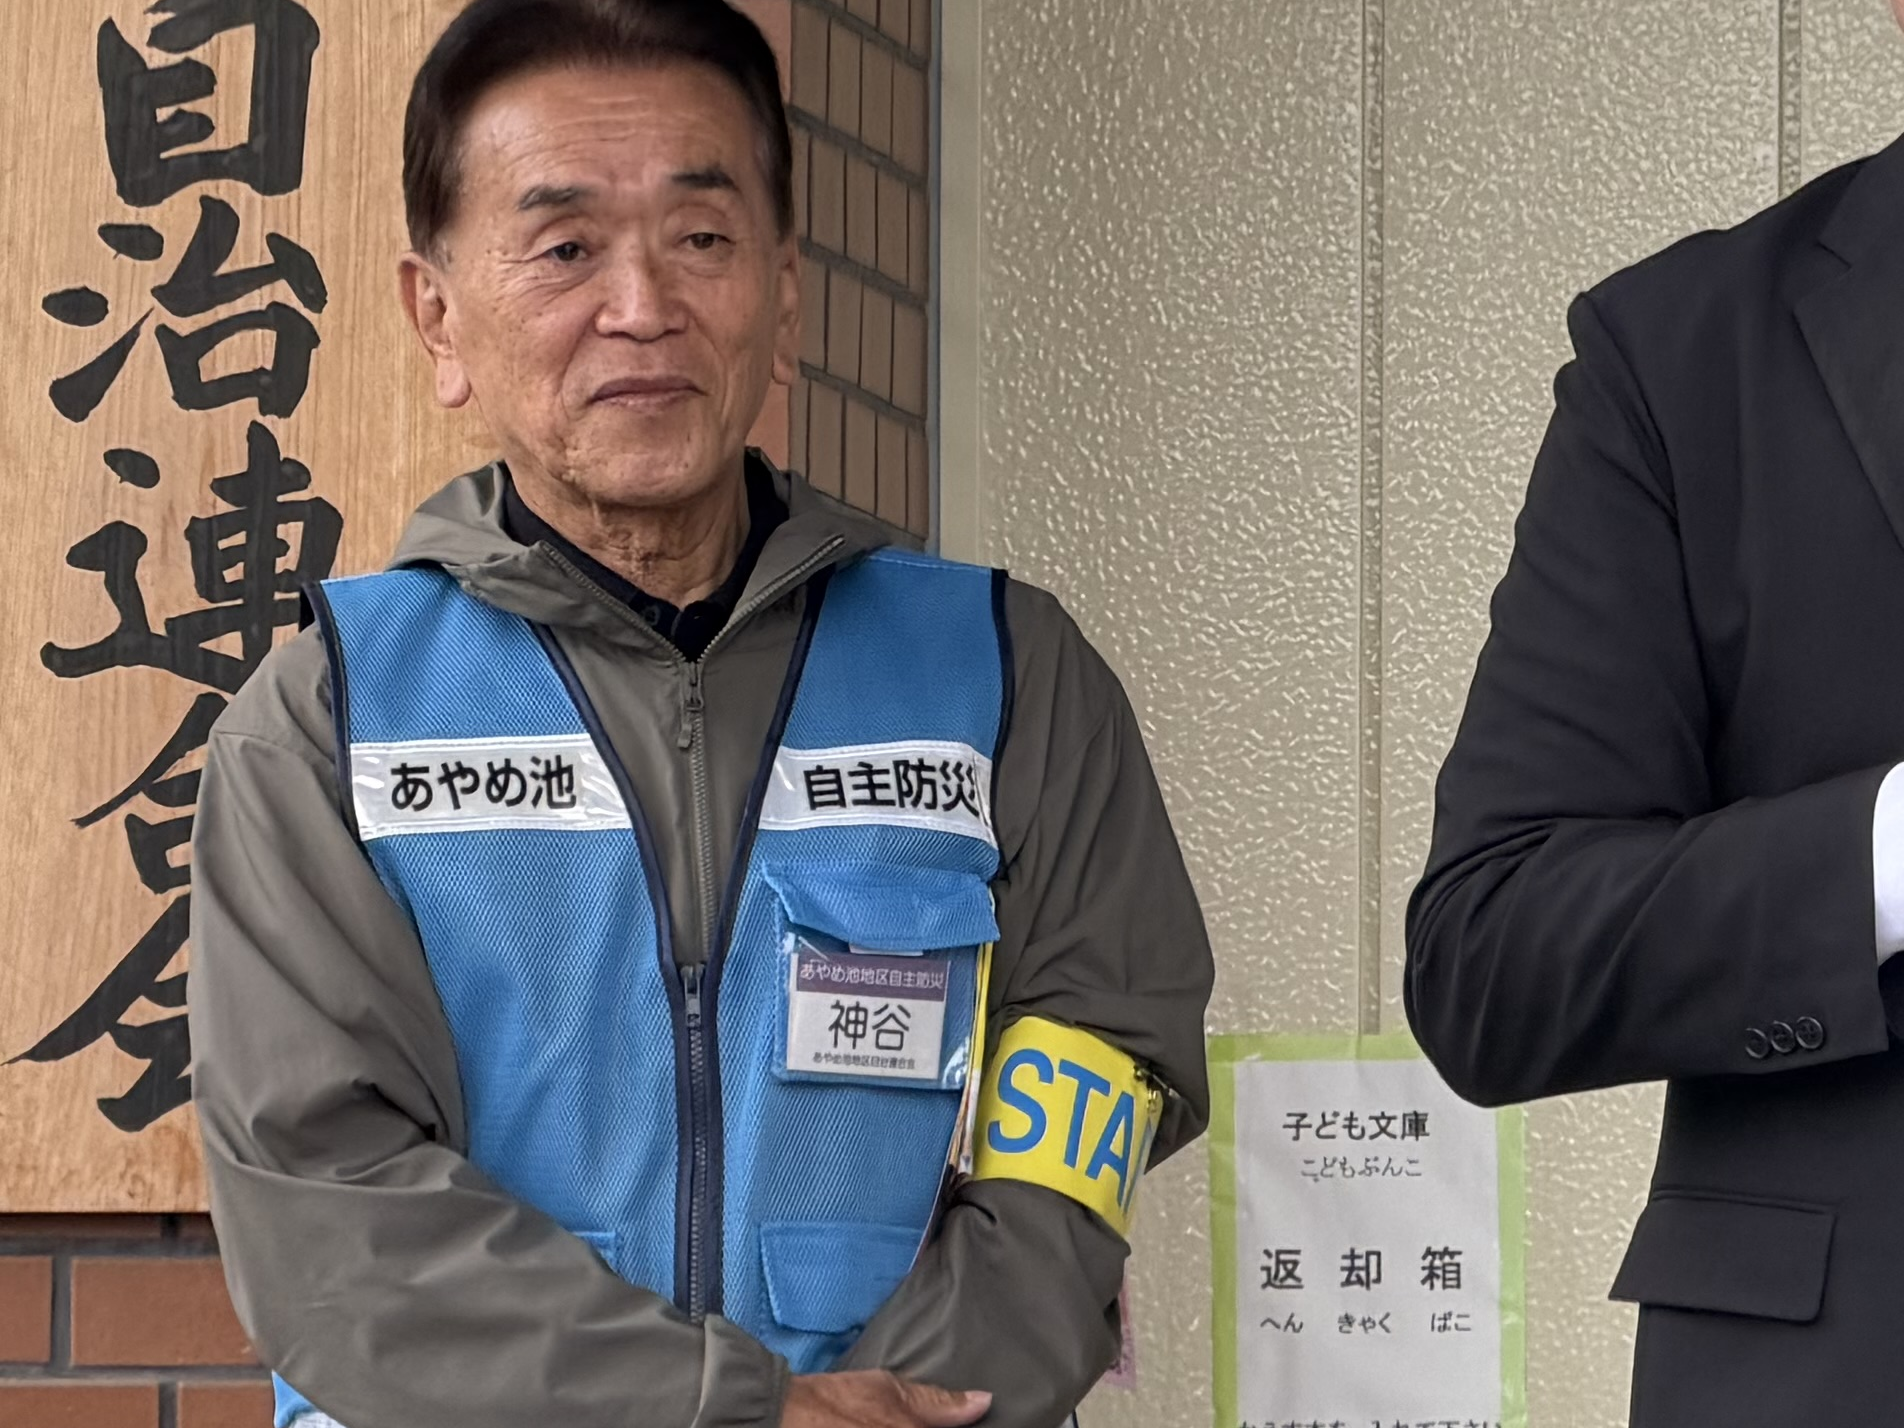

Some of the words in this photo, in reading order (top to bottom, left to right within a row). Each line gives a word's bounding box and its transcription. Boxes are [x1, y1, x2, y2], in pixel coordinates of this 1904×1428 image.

[388, 754, 579, 811] あやめ池
[802, 757, 981, 819] 自主防災
[827, 999, 913, 1051] 神谷
[986, 1047, 1146, 1214] STA
[1282, 1109, 1431, 1142] 子ども文庫
[1300, 1155, 1424, 1179] こどもぶんこ
